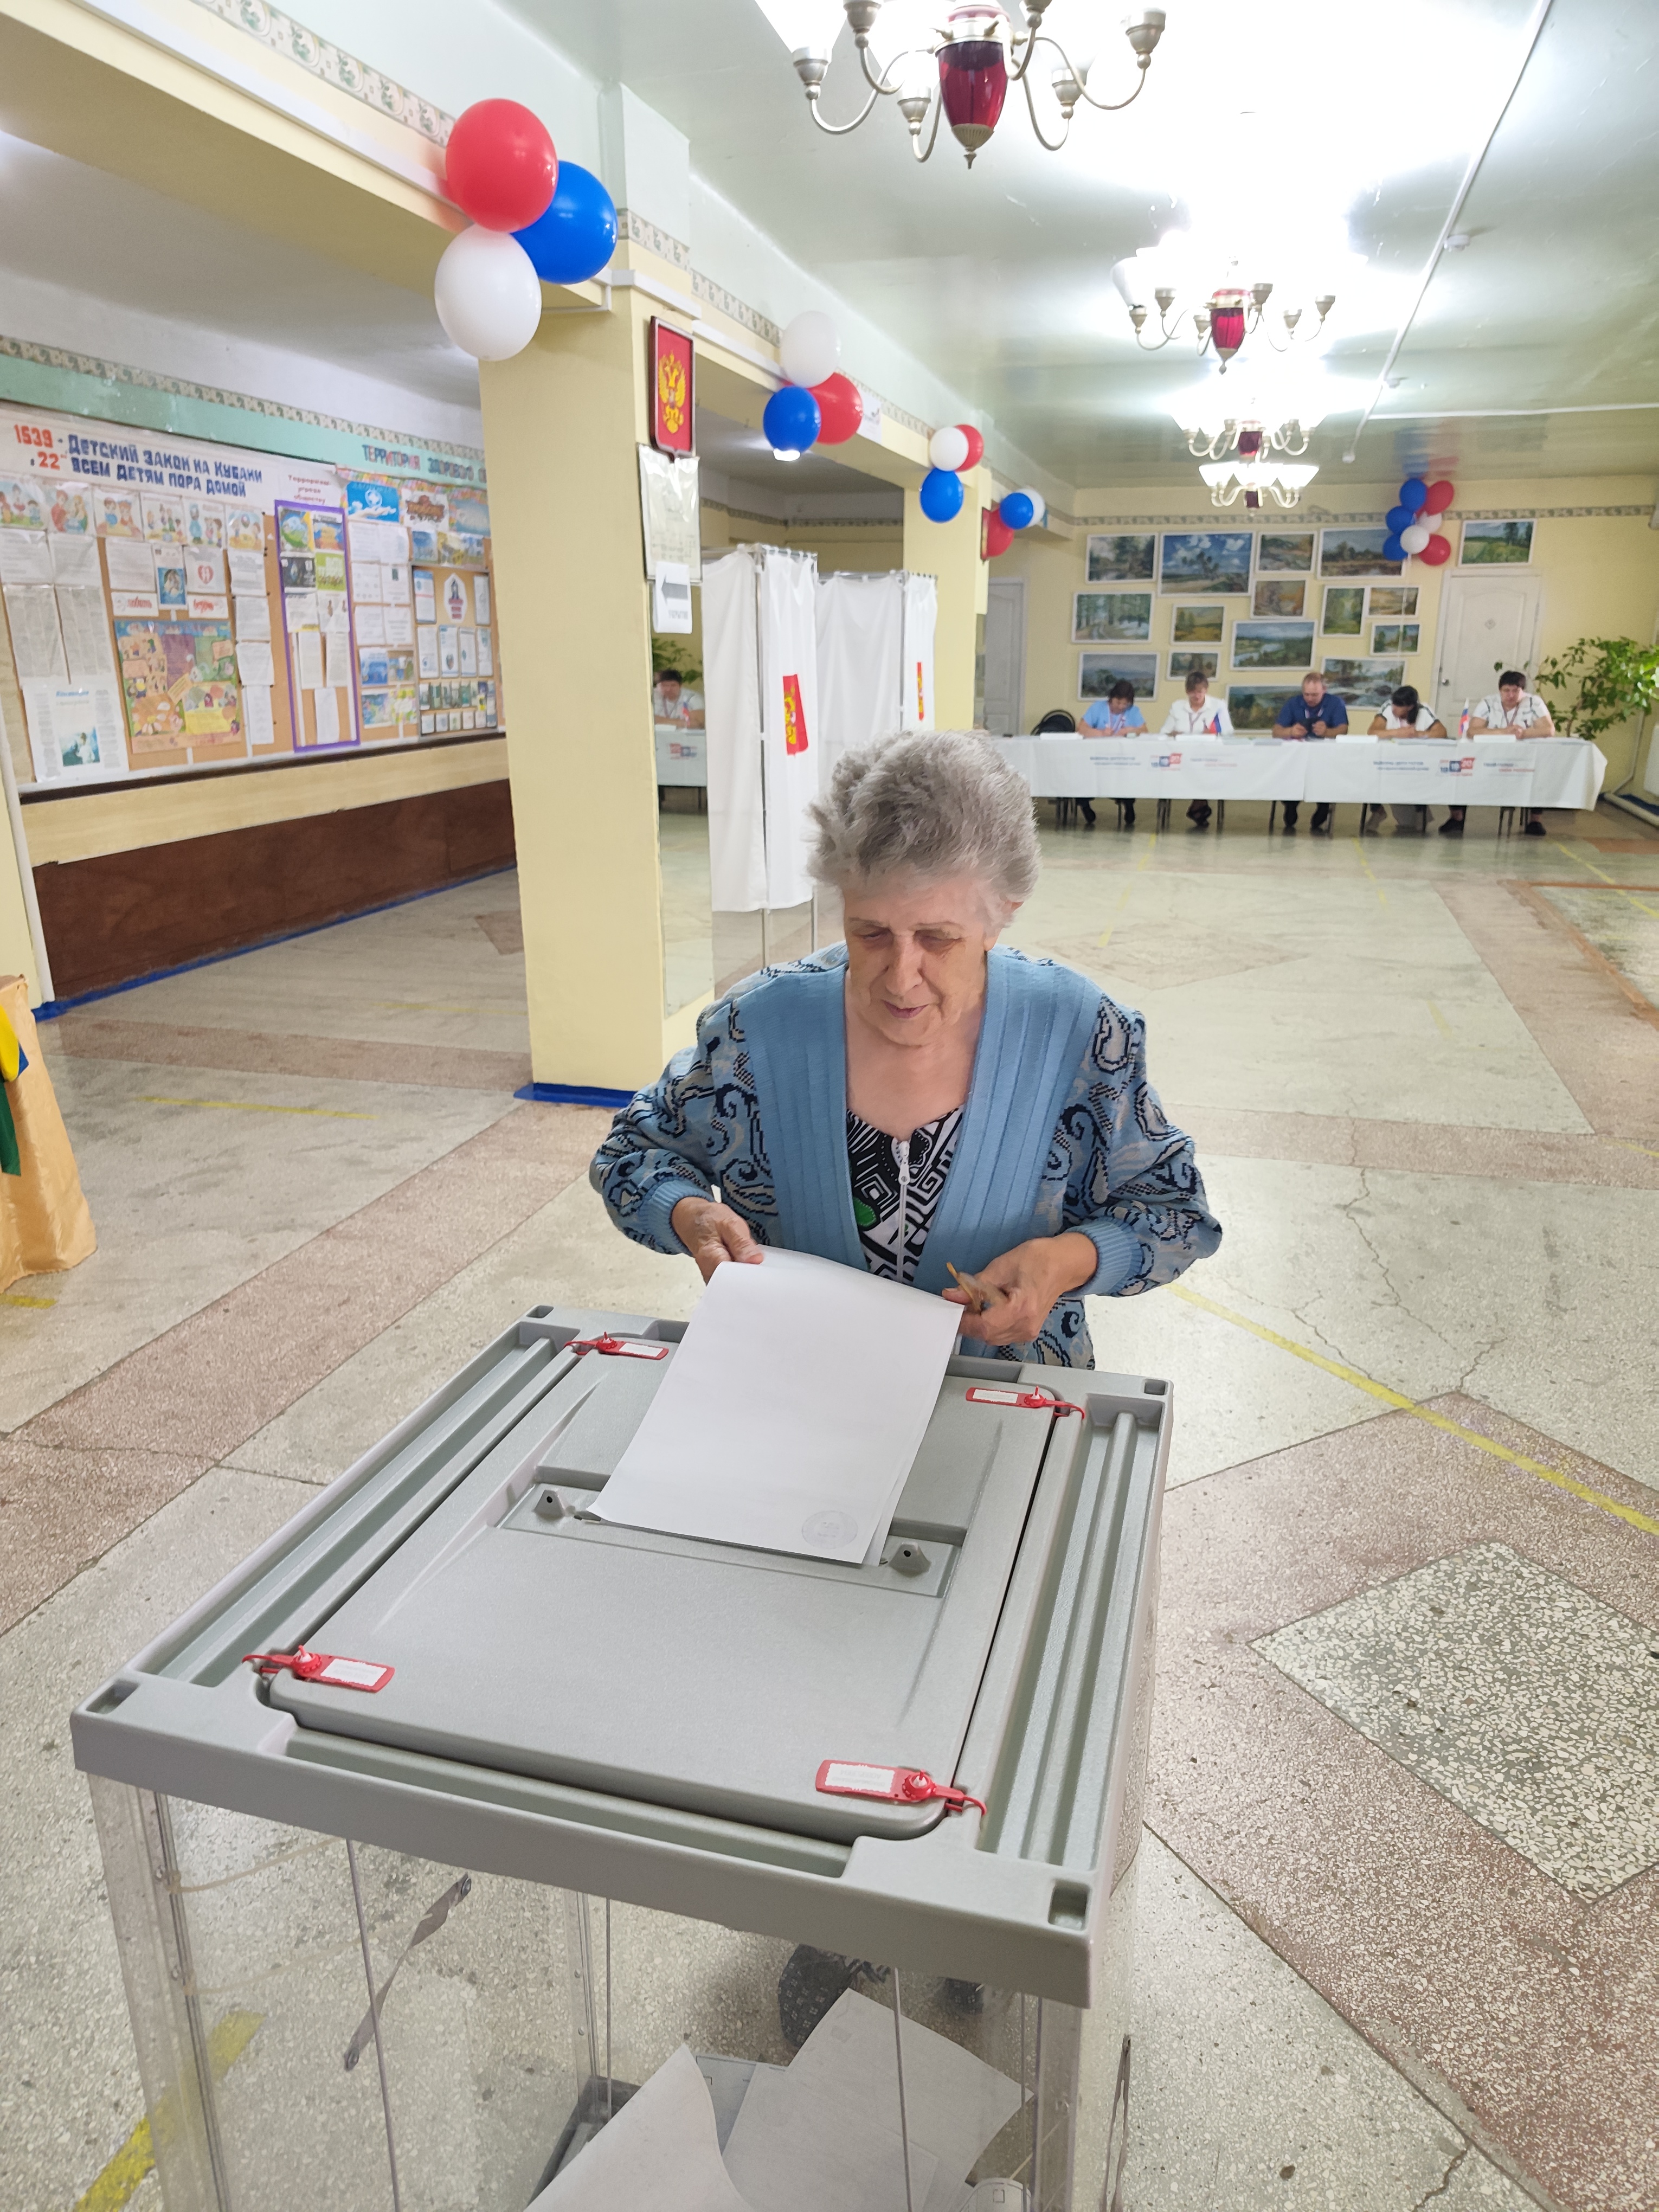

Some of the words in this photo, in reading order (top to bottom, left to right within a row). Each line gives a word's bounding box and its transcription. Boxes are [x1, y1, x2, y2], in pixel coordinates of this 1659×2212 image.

[14, 425, 53, 448] 1539
[68, 434, 139, 464] ДЕТСКИЙ
[143, 449, 190, 472] ЗАКОН
[194, 459, 210, 475] НА
[214, 461, 262, 483] КУБАНИ
[37, 451, 60, 471] 22
[117, 464, 164, 485] ДЕТЯМ
[169, 473, 201, 491] ПОРА
[207, 479, 246, 497] ДОМОЙ
